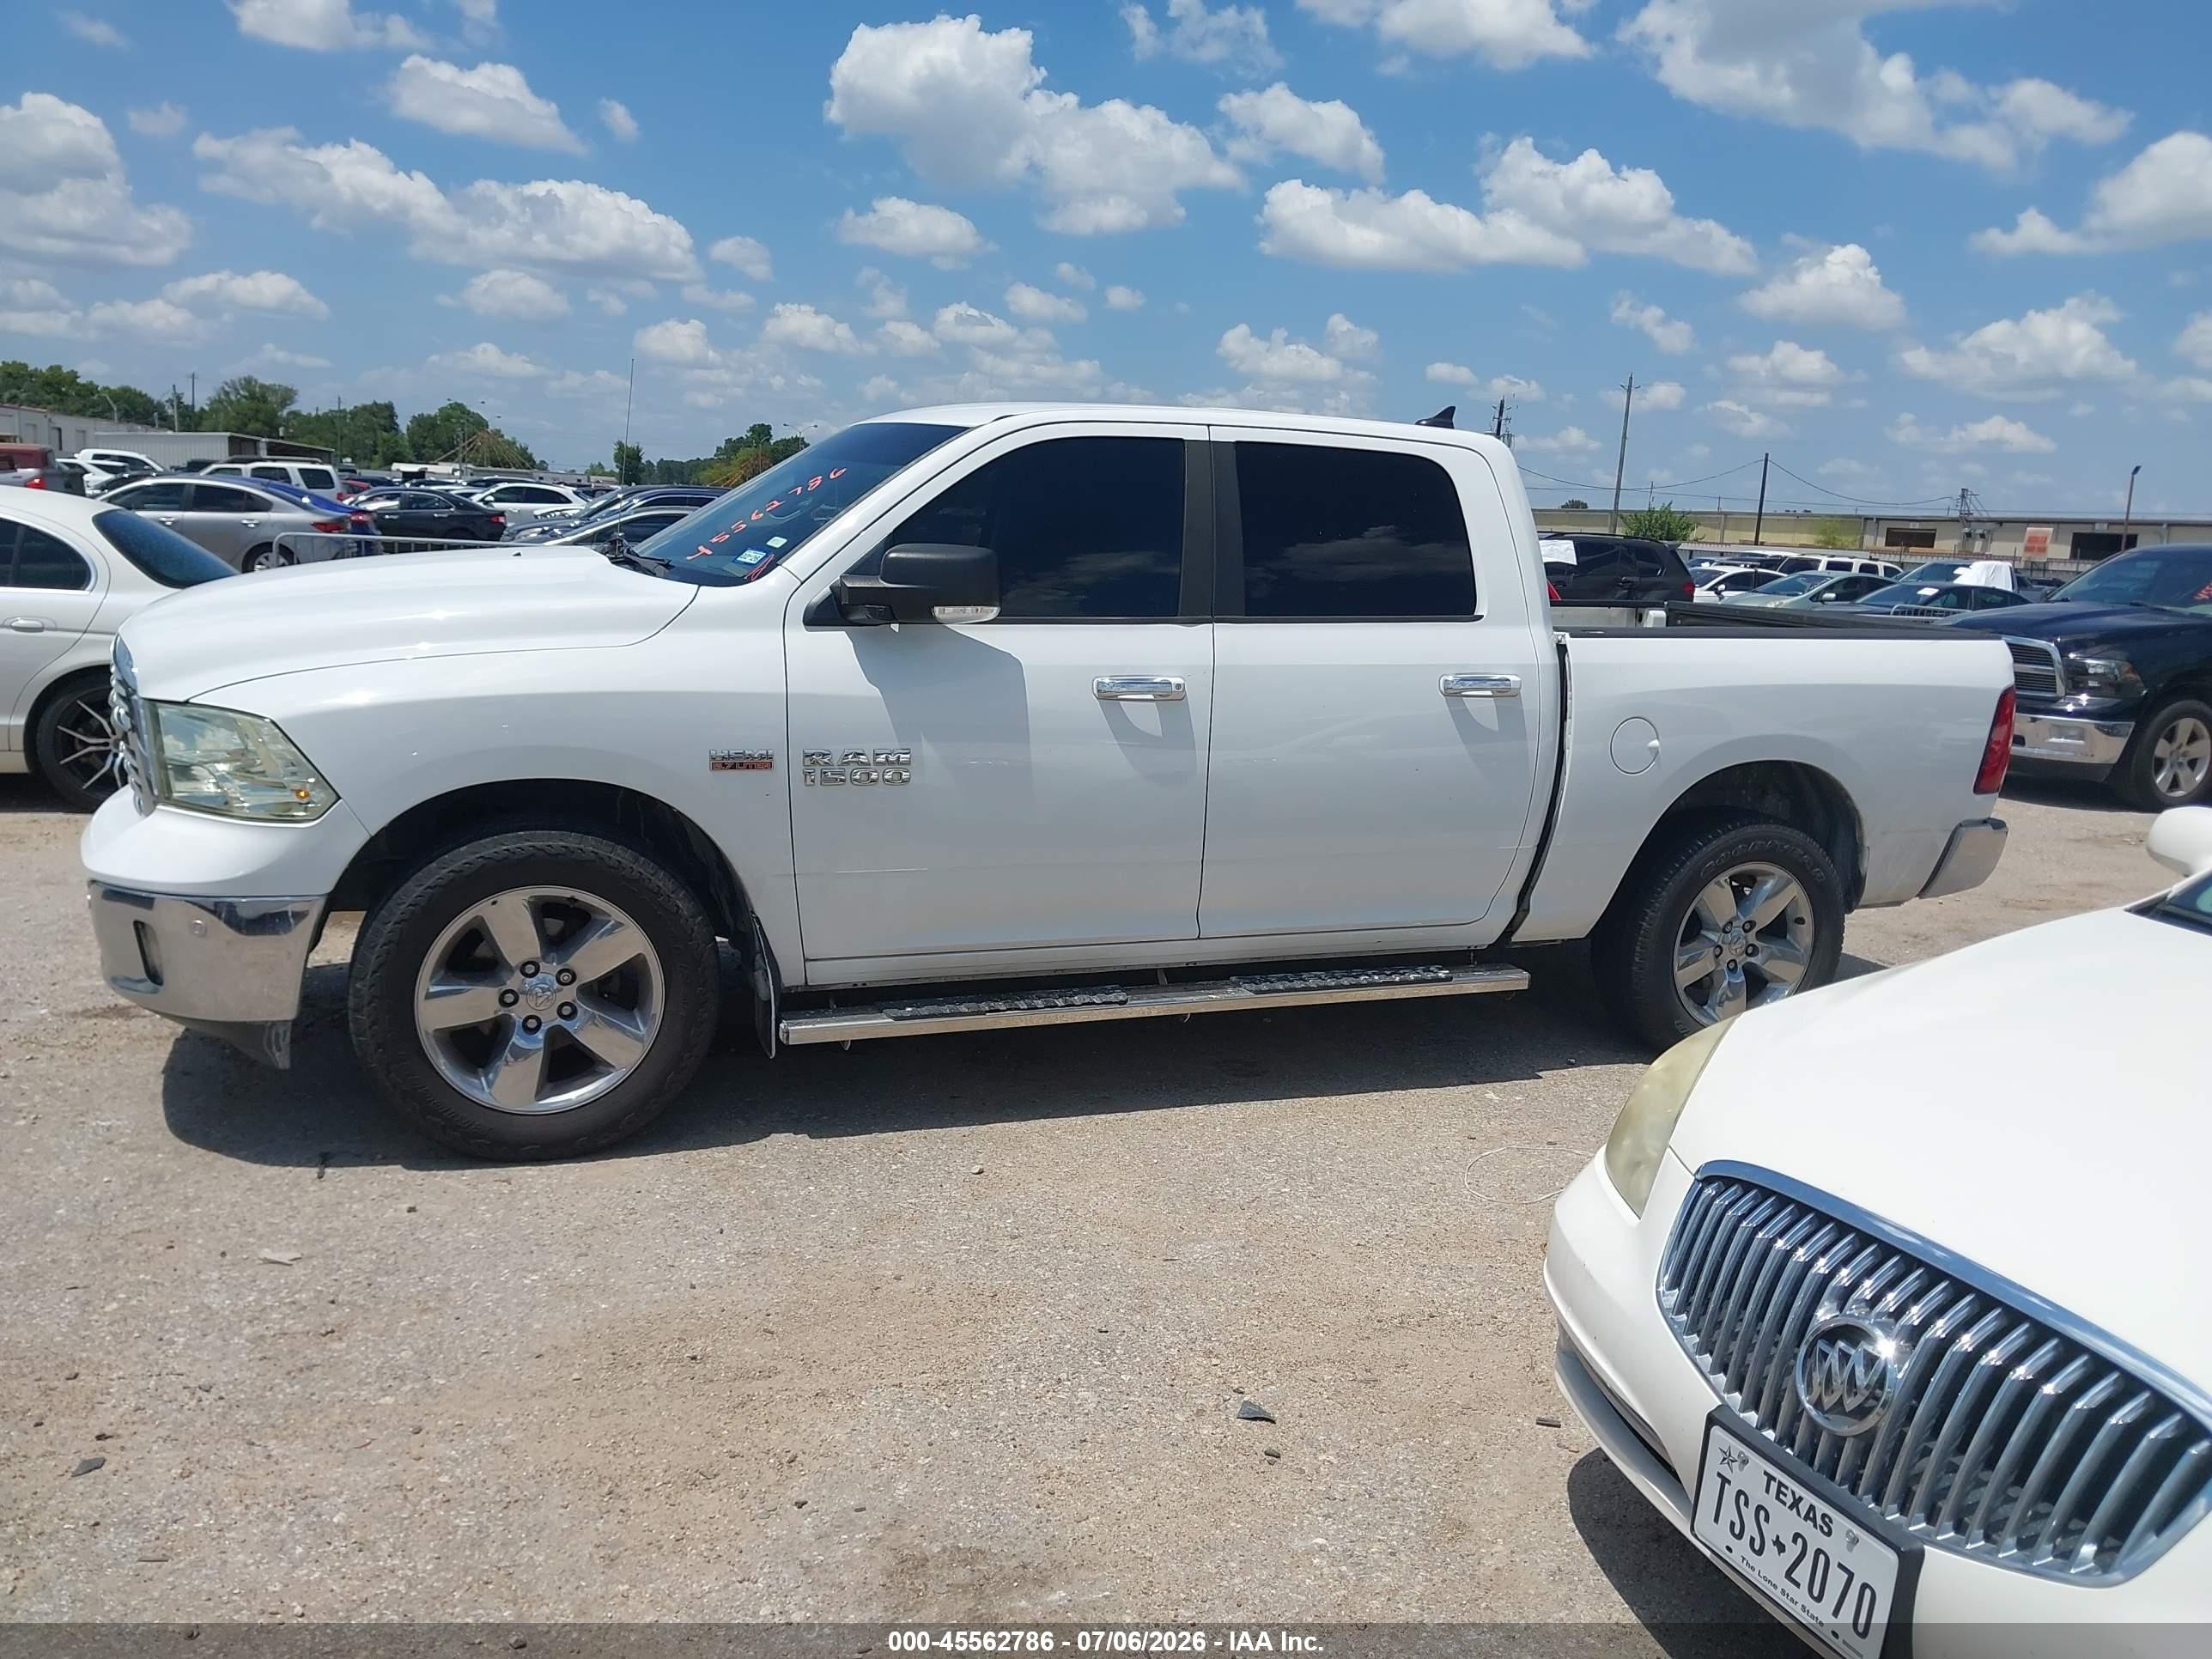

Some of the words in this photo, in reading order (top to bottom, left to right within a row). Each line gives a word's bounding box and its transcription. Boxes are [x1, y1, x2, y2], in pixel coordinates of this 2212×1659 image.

[709, 749, 774, 761] HEMI
[803, 749, 911, 767] RAM
[803, 768, 911, 787] 1500
[1763, 1469, 1834, 1538] TEXAS
[1741, 1555, 1756, 1573] The
[1758, 1569, 1778, 1590] Lone
[1780, 1588, 1799, 1607] Star
[1801, 1603, 1825, 1628] State
